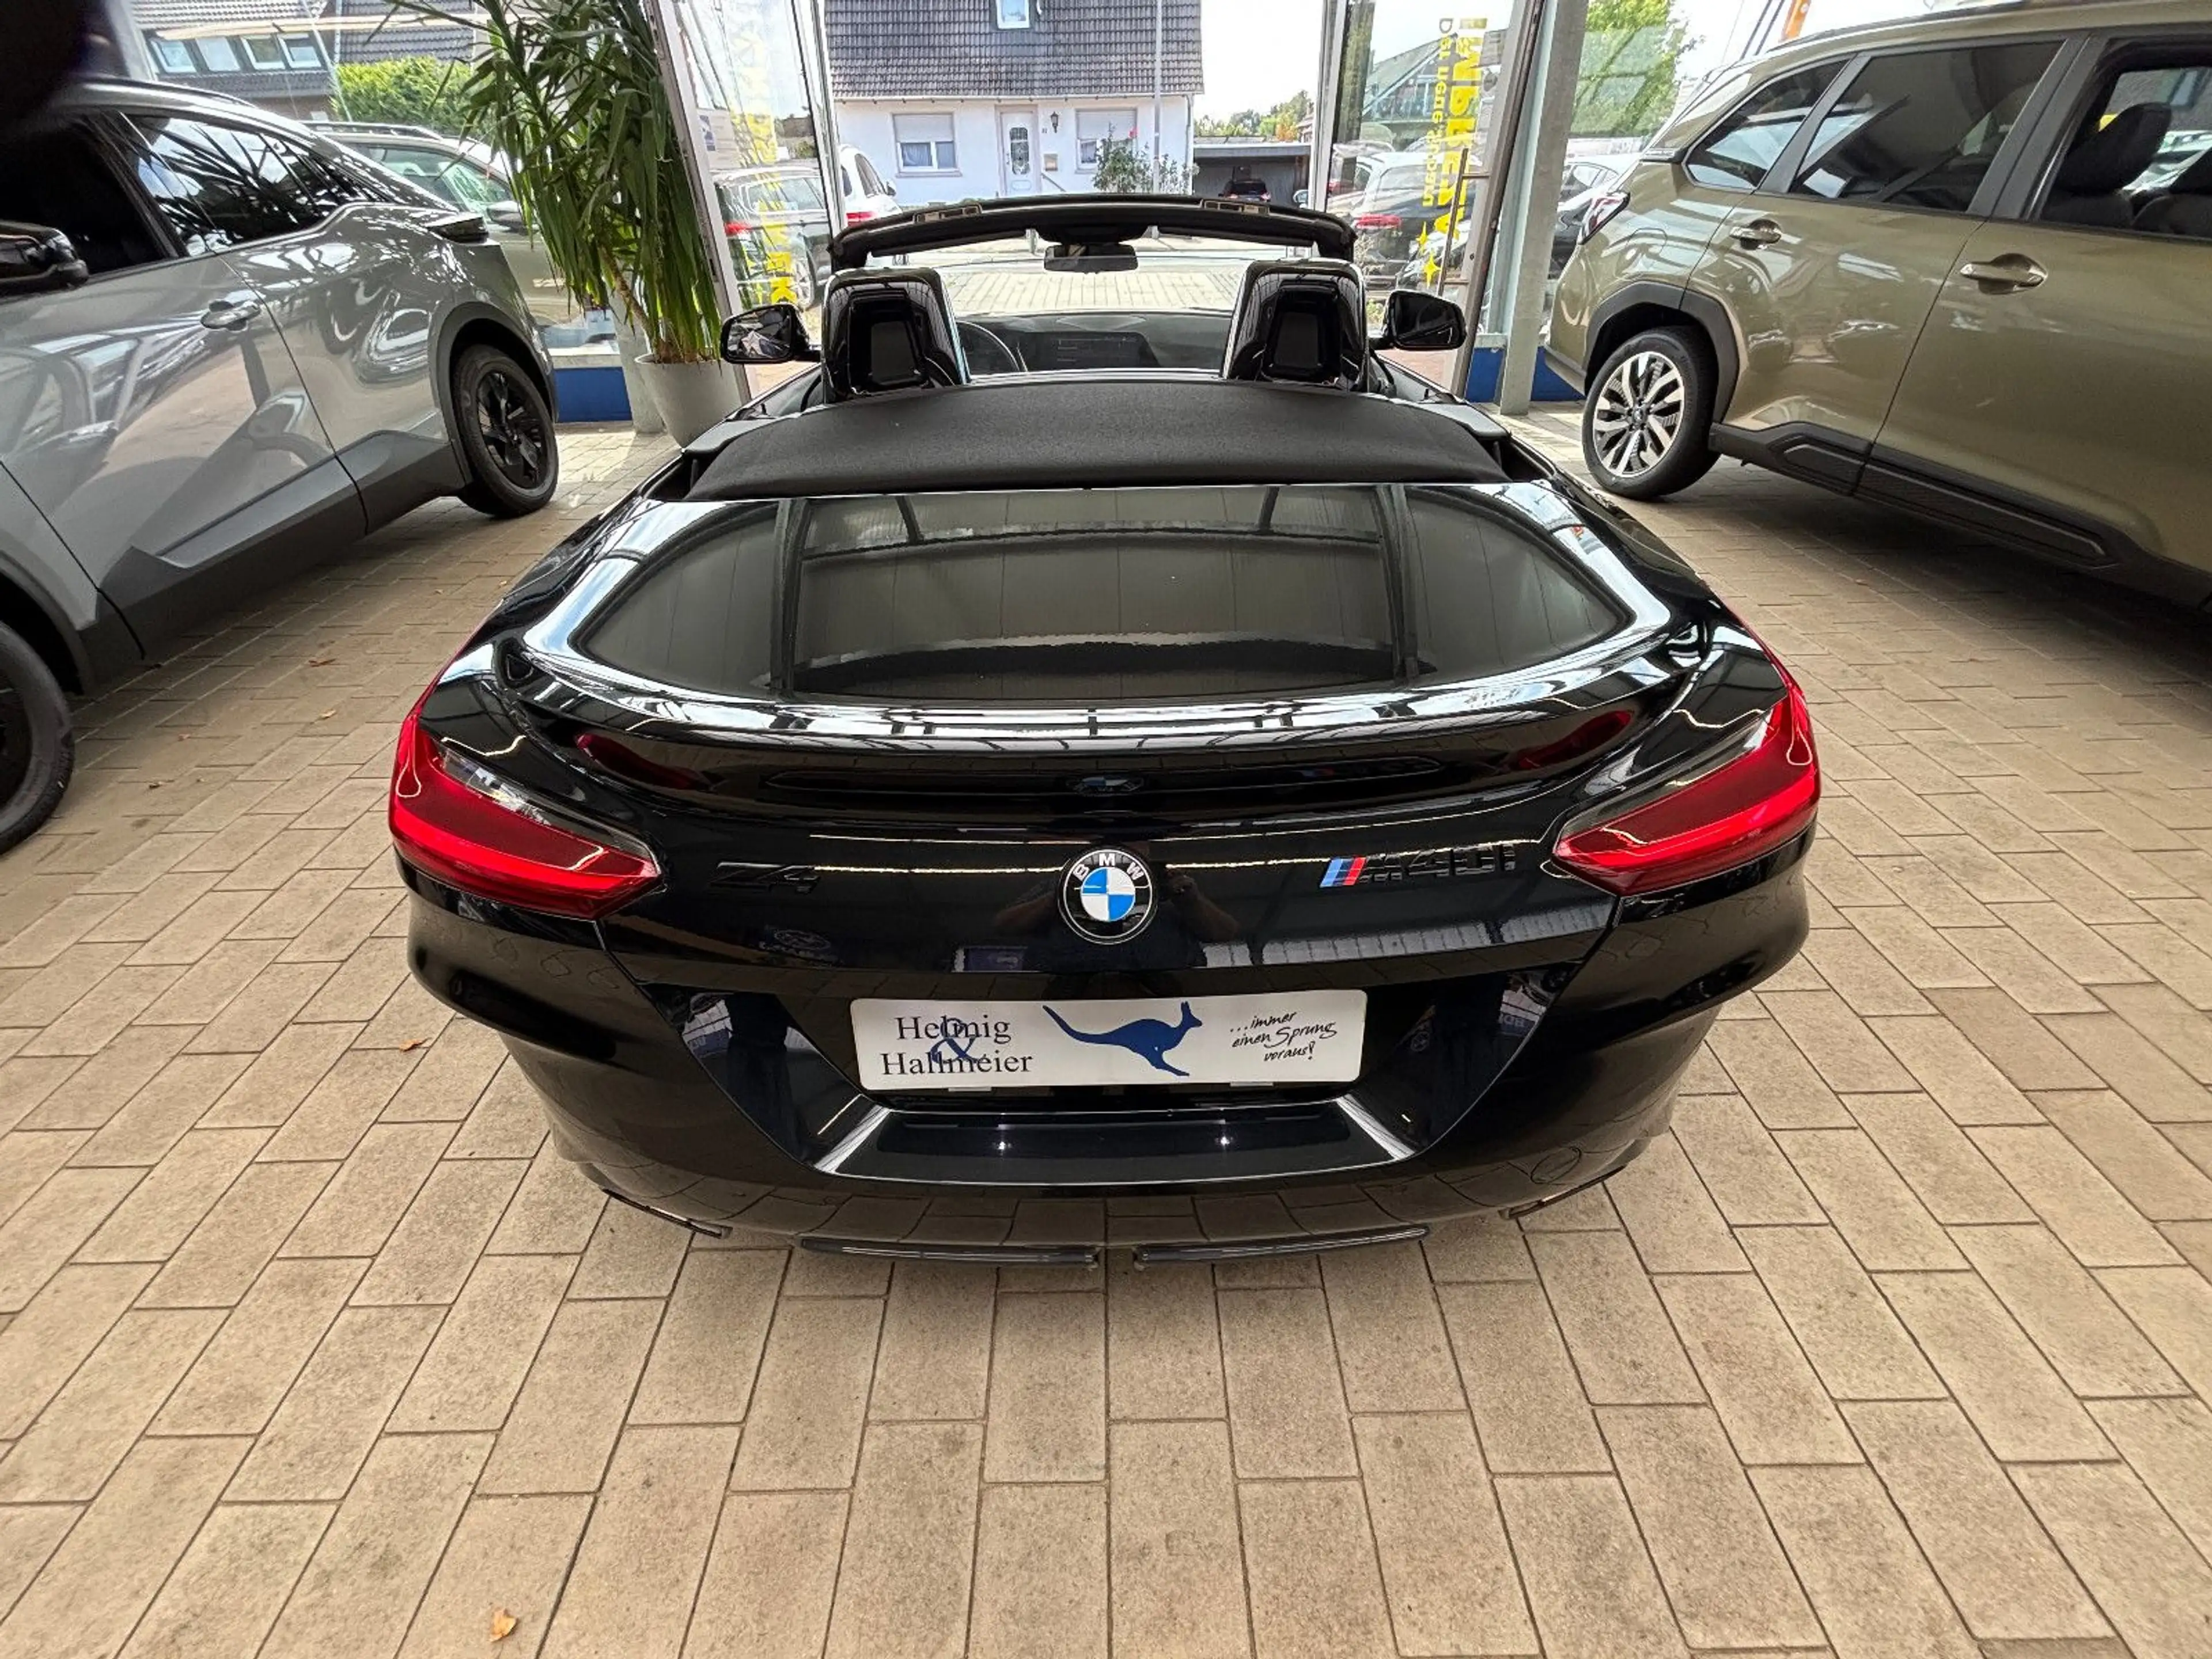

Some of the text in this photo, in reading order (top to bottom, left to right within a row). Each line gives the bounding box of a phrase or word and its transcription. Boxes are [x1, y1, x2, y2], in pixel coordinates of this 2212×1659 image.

[707, 862, 821, 895] Z4
[1073, 853, 1144, 881] BMW
[894, 1014, 1012, 1044] Helmig
[930, 1017, 983, 1064] &
[1232, 1022, 1337, 1048] einen Sprung
[880, 1050, 1033, 1075] Hallmeier
[1264, 1040, 1316, 1062] voraus!
